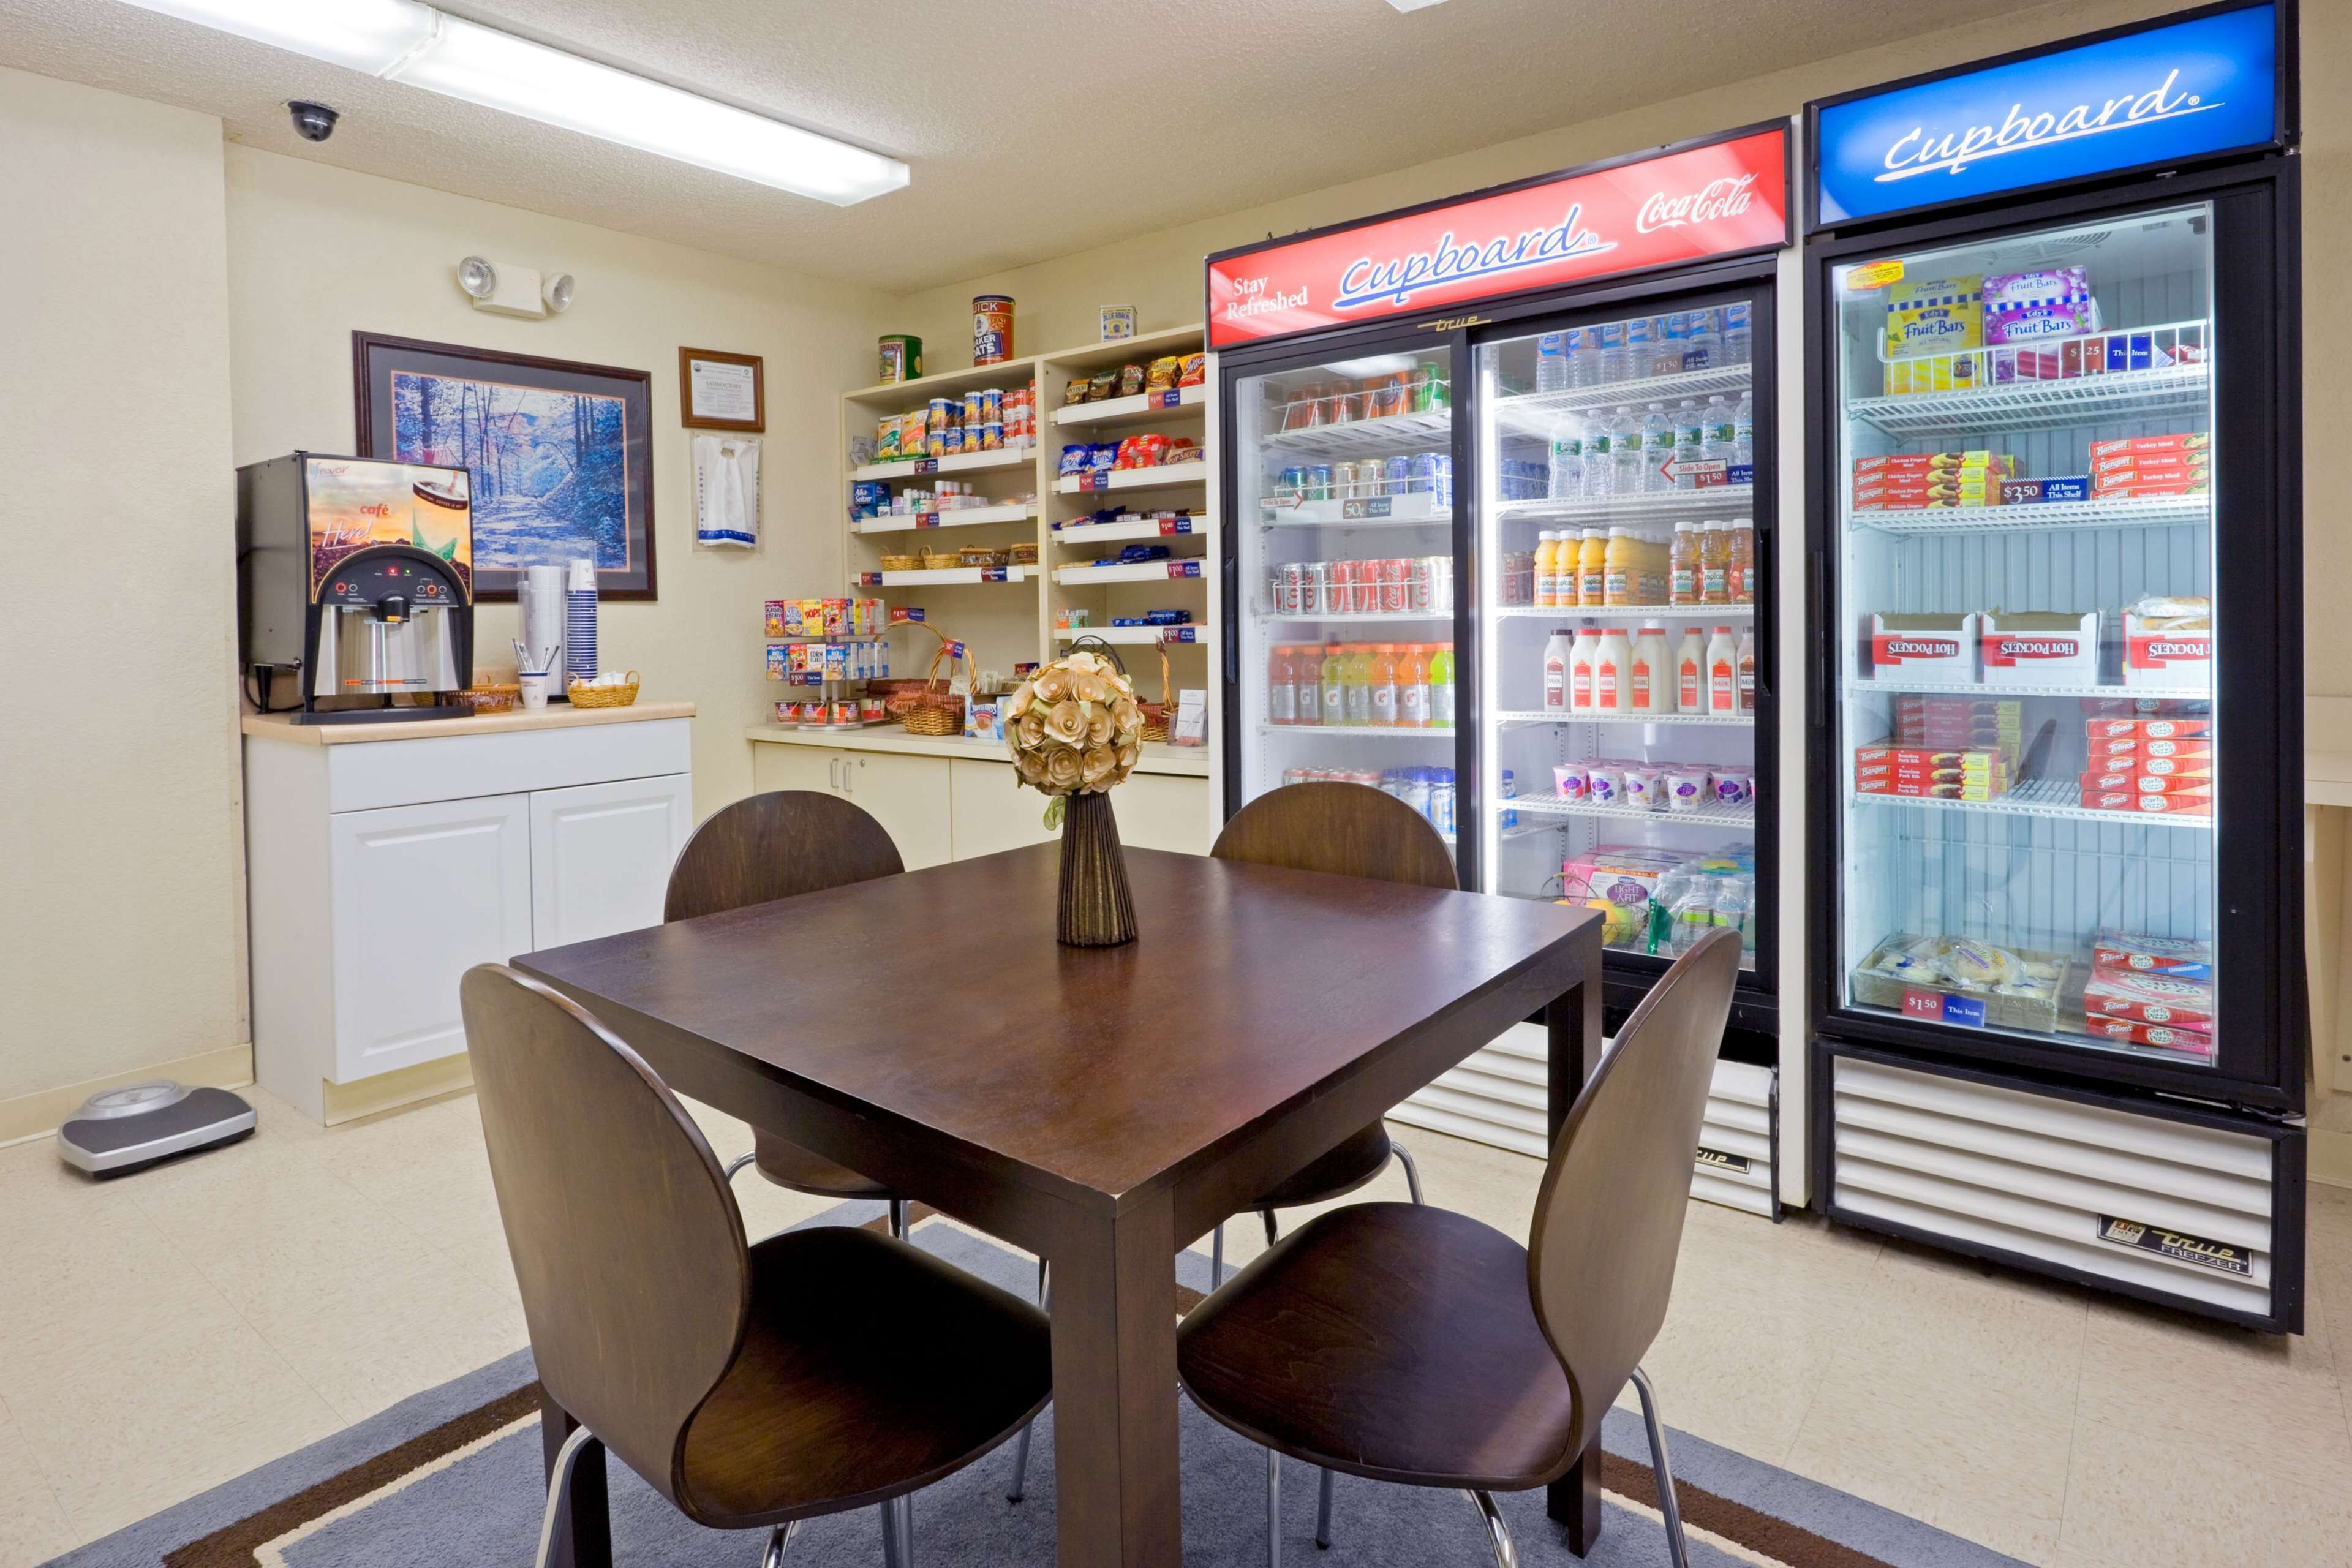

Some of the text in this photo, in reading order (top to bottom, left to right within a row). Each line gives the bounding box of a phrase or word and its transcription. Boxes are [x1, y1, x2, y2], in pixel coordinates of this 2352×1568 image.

[1635, 172, 1760, 234] Coca-Cola
[1234, 277, 1270, 296] Stay
[2010, 279, 2057, 292] Fruit Bars
[1226, 285, 1308, 320] Refreshed
[1903, 320, 1965, 339] Fruit Bars
[2003, 319, 2072, 337] Fruit Bars
[2096, 441, 2128, 454] Banquet
[2098, 457, 2131, 470] Banquet
[314, 461, 350, 481] Savor
[2102, 472, 2135, 486] Banquet
[2062, 490, 2082, 499] Shelf
[360, 503, 389, 518] café
[321, 519, 374, 547] Here!
[804, 608, 821, 619] POPS
[1887, 642, 1932, 655] POCKETS
[2000, 641, 2049, 655] POCKETS
[2147, 643, 2204, 657] POCKETS
[1861, 752, 1888, 761] Banquet
[1861, 767, 1888, 777] Banquet
[1861, 782, 1887, 791] Banquet
[2161, 1244, 2241, 1271] FREEZER
